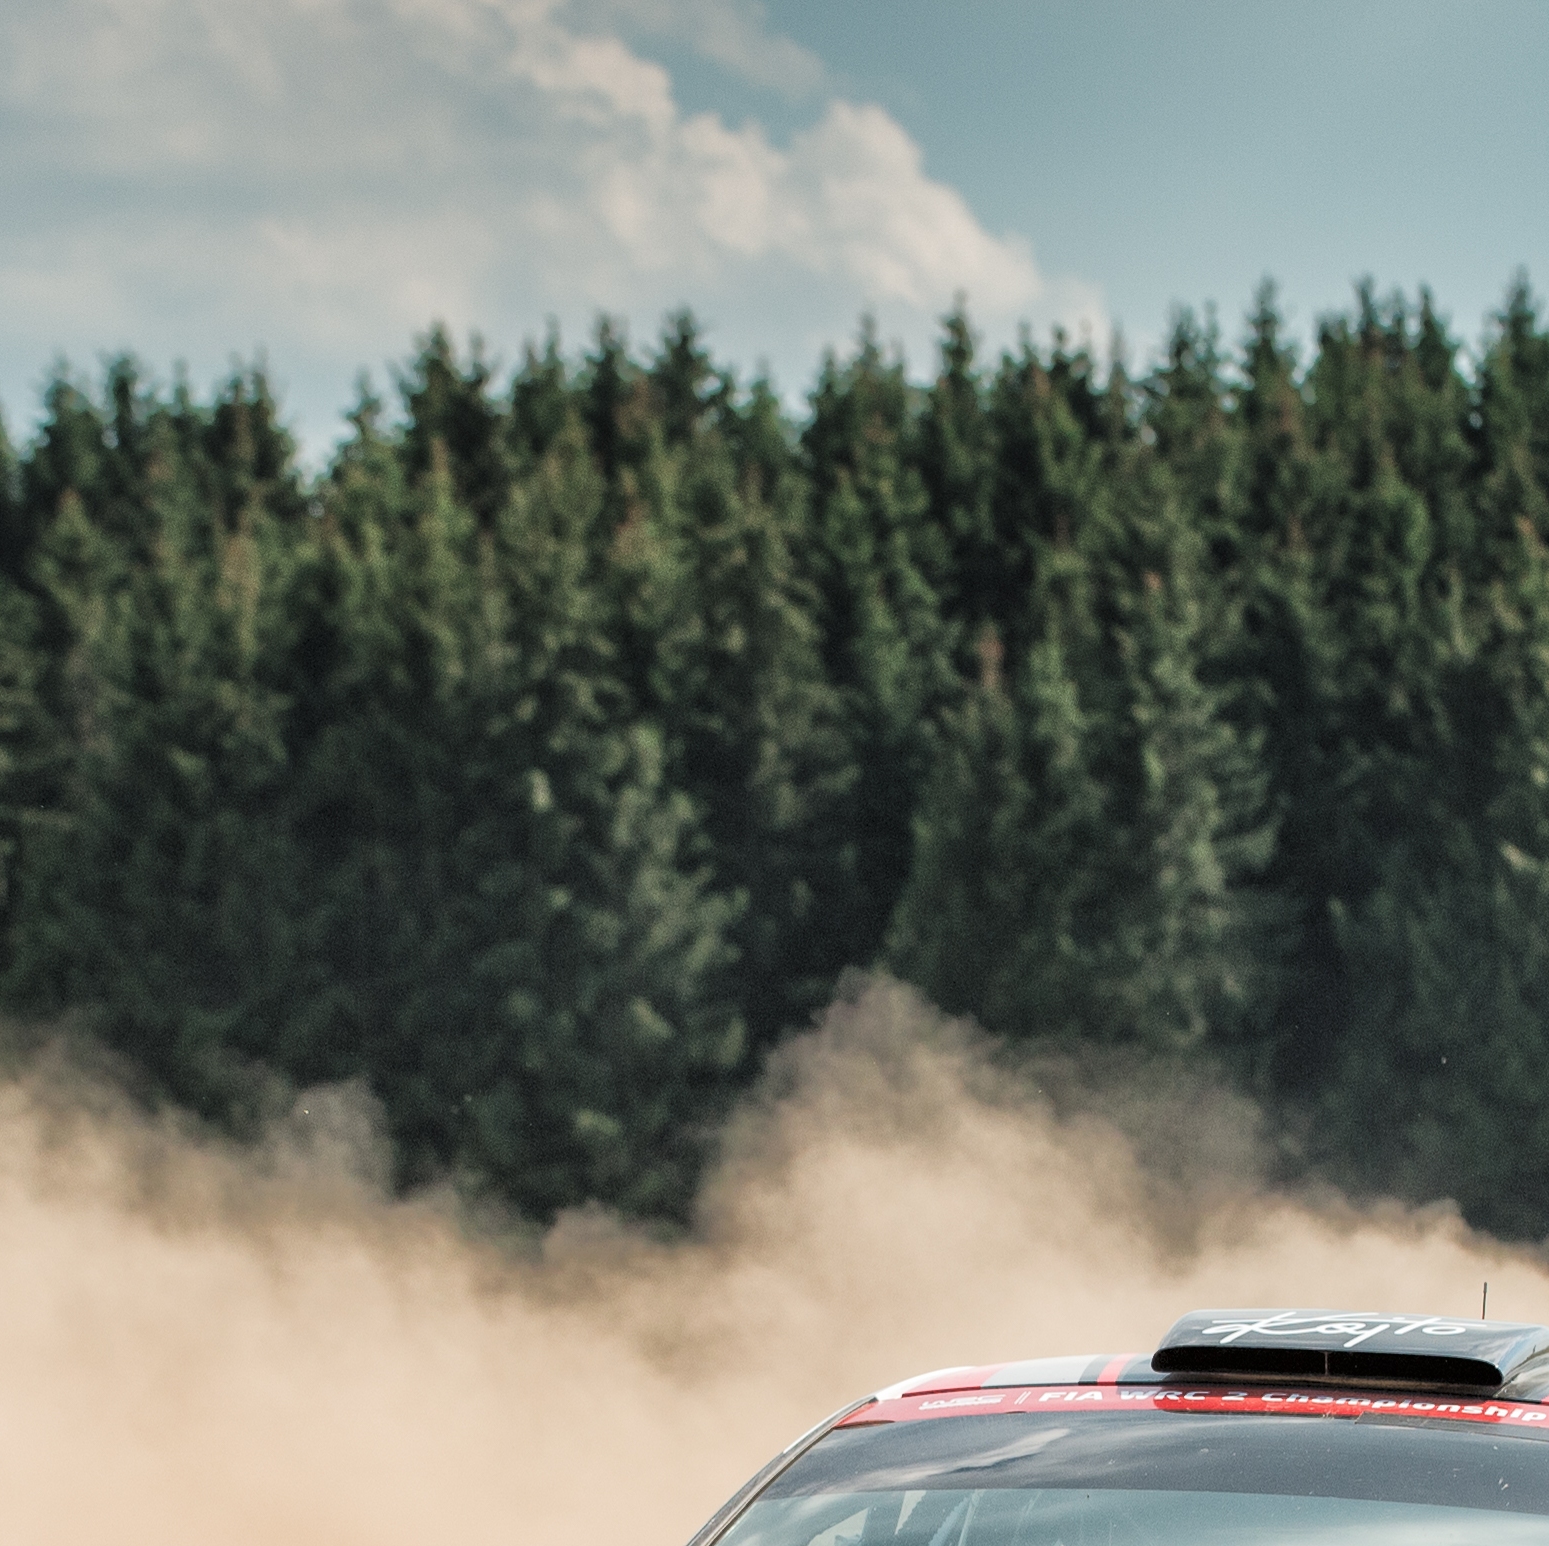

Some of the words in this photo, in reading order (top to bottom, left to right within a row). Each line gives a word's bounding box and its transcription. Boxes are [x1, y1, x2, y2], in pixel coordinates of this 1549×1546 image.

[1037, 1390, 1103, 1402] FIA
[1120, 1390, 1211, 1401] WRC
[1221, 1390, 1249, 1402] 2
[1261, 1392, 1548, 1422] Championship
